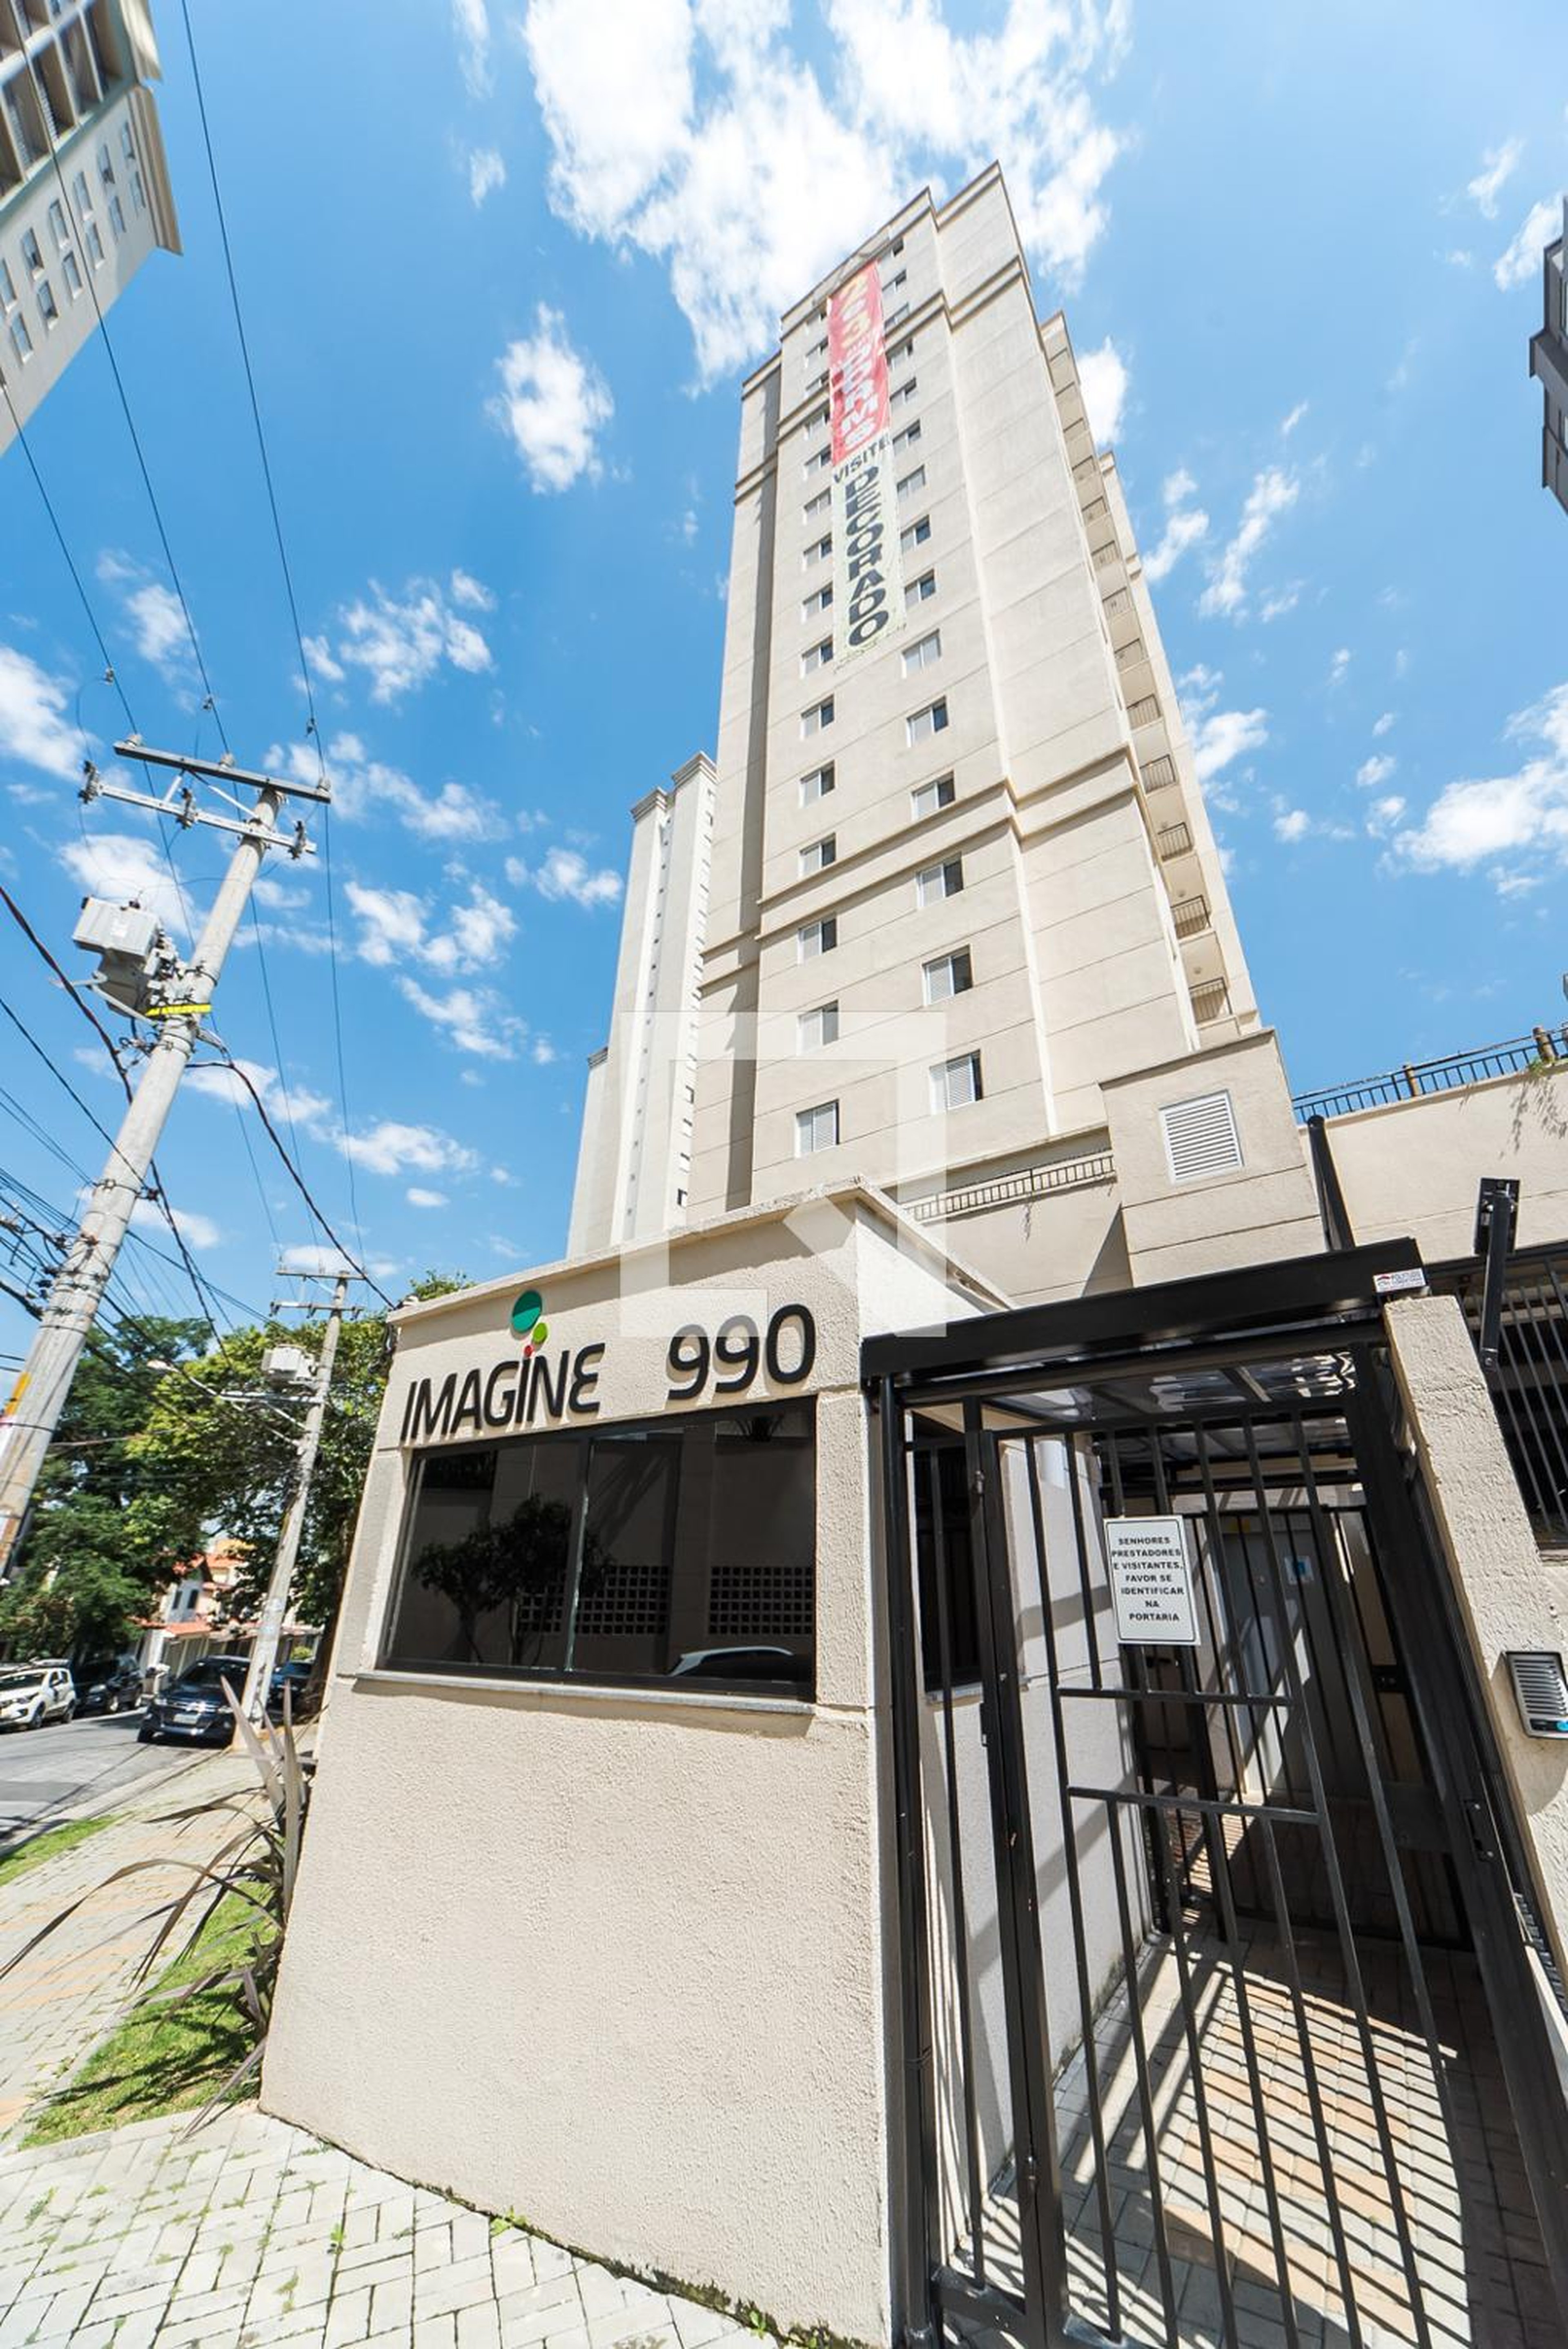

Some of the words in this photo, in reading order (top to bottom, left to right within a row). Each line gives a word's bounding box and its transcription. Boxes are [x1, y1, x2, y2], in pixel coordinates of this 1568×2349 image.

[845, 466, 889, 646] DECORADO
[400, 1343, 605, 1442] IMAGINE
[667, 1304, 817, 1400] 990
[1118, 1537, 1170, 1545] SENHORES
[1111, 1549, 1182, 1557] PRESTADORES
[1121, 1587, 1184, 1595] IDENTIFICAR
[1129, 1613, 1180, 1621] PORTARIA
